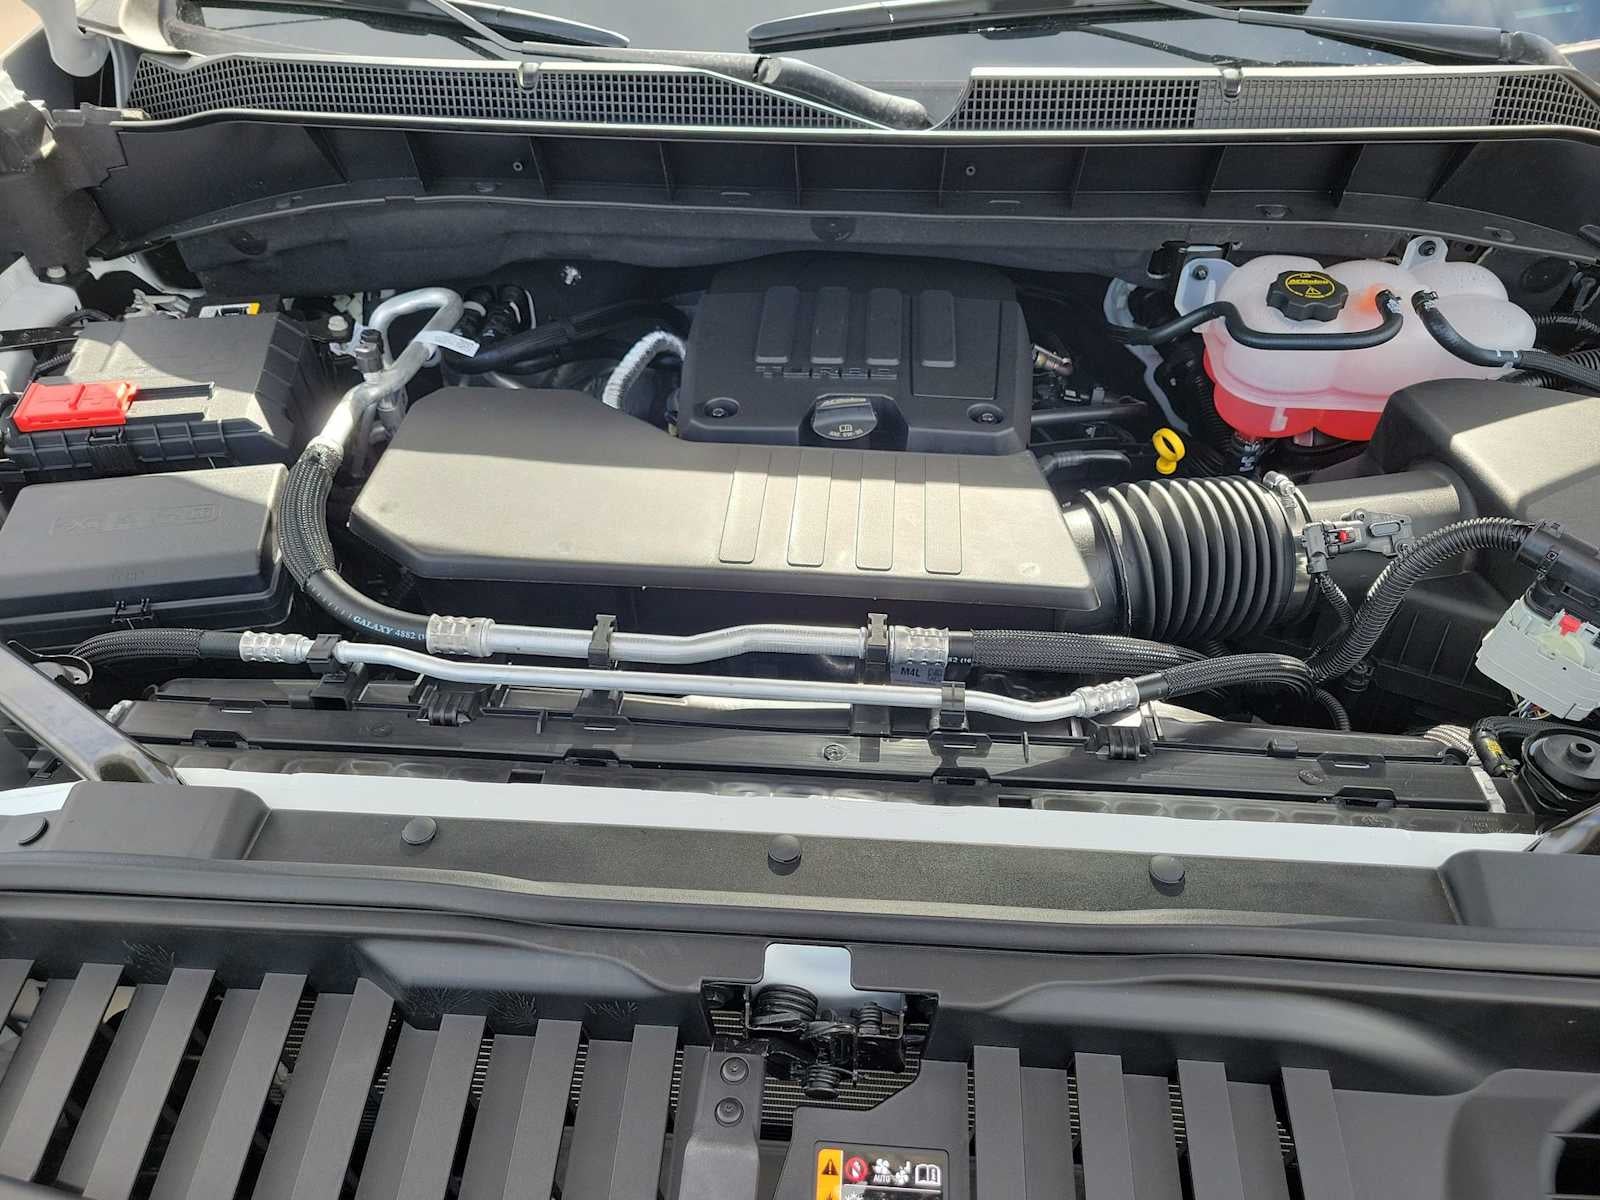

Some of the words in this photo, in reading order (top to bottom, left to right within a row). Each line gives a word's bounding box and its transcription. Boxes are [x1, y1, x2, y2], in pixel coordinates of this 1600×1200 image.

[353, 615, 393, 635] GALAXY
[900, 667, 920, 677] M4L
[873, 1174, 891, 1185] AUTO
